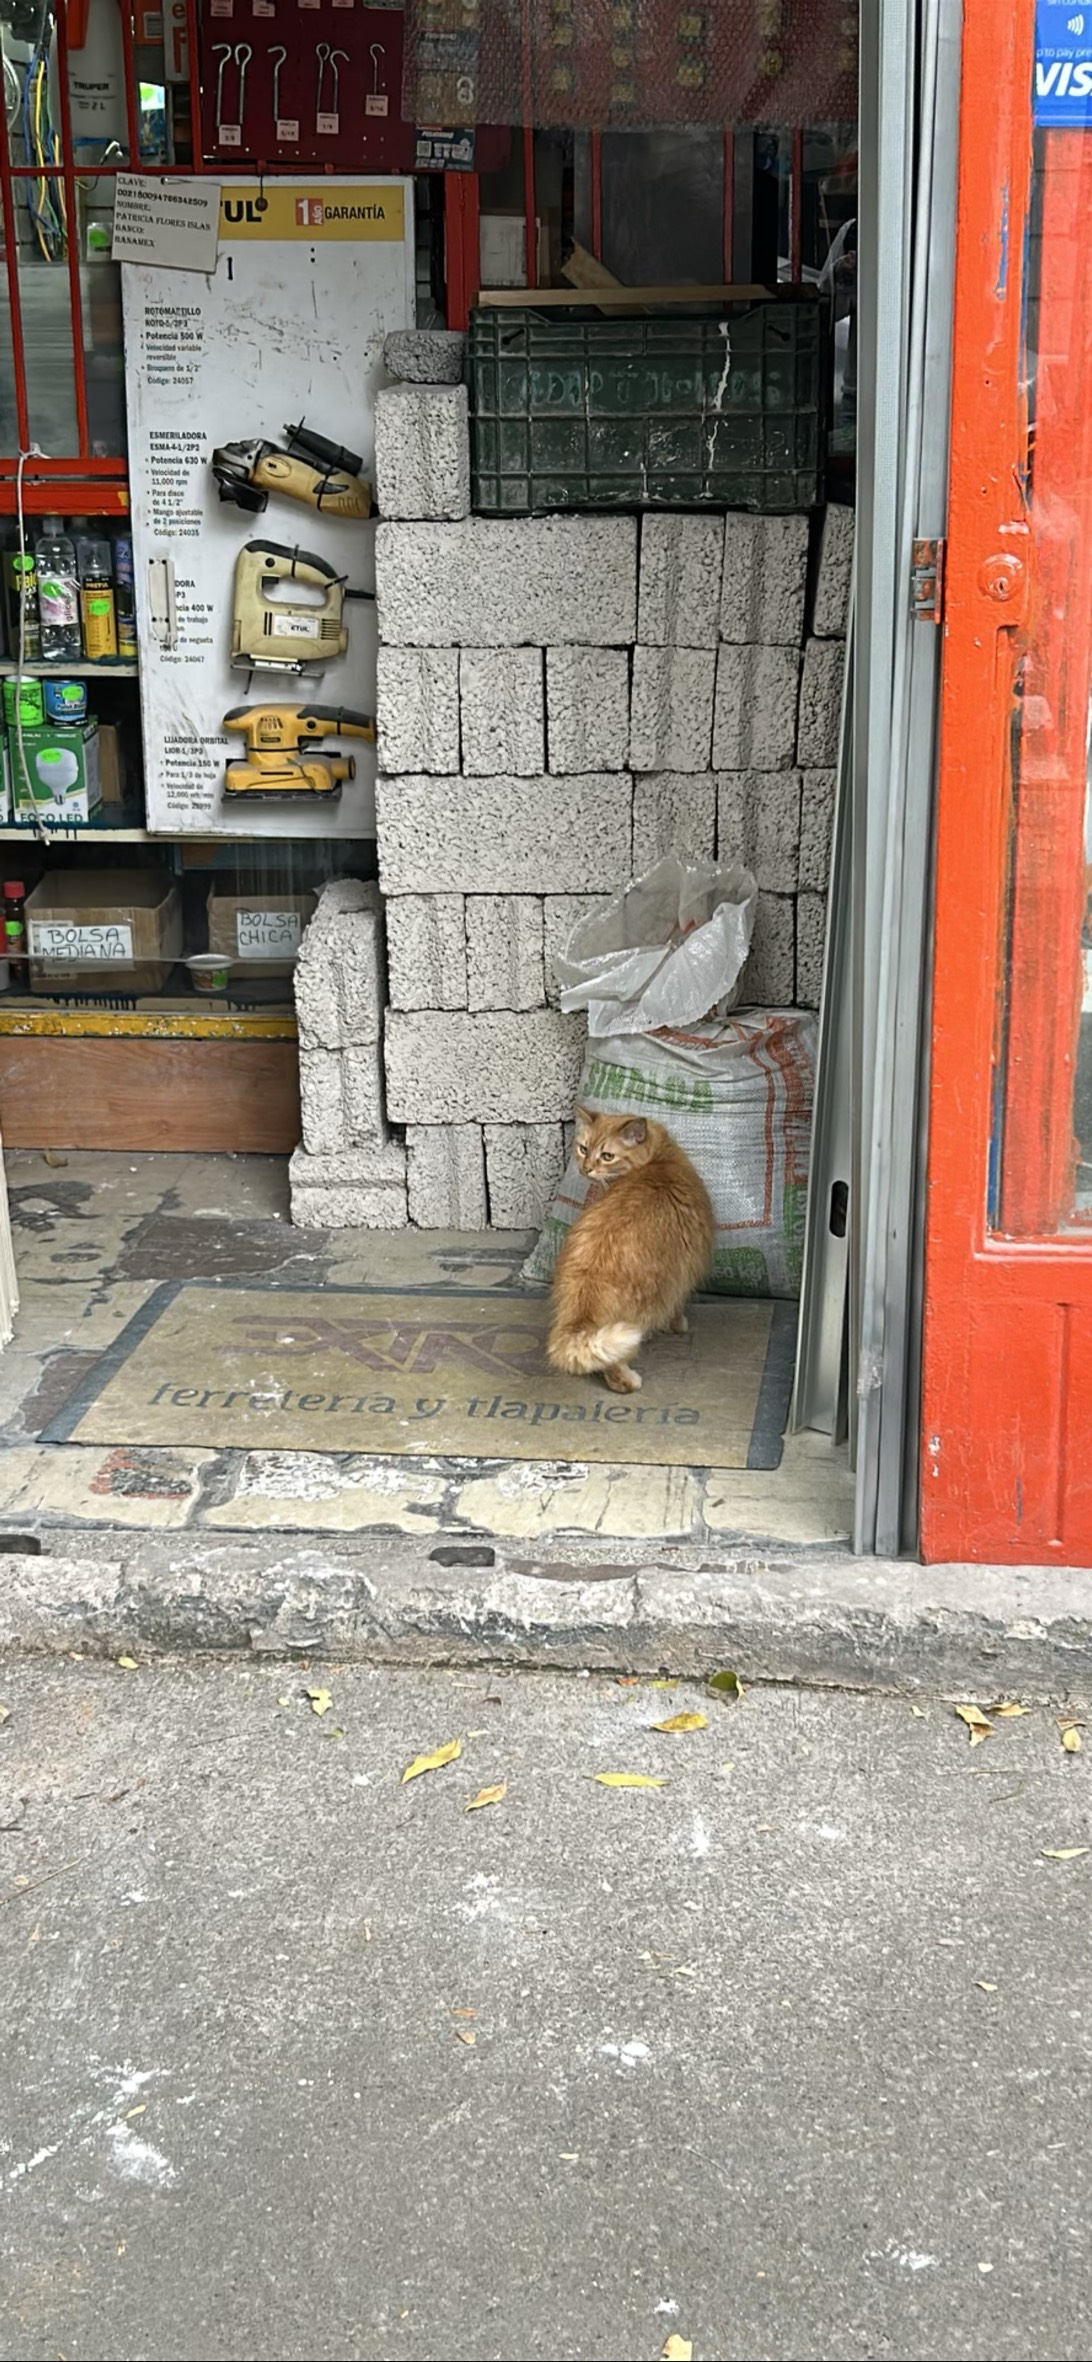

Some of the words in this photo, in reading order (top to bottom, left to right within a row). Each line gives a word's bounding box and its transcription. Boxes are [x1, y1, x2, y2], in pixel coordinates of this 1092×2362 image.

[1036, 62, 1092, 96] VIS
[220, 199, 262, 223] UL
[324, 204, 386, 220] GARANTÍA
[116, 211, 154, 225] PATRICIA
[156, 216, 186, 229] FLORES
[187, 220, 211, 231] ISLAS
[114, 235, 155, 248] BANAMEX
[149, 431, 208, 440] ESMERILADORA
[150, 456, 183, 465] Potencia
[152, 489, 166, 497] Para
[174, 580, 196, 588] DORA
[163, 736, 198, 744] LIJADORA
[199, 737, 229, 745] ORBITAL
[165, 760, 197, 768] Potencia
[236, 908, 299, 929] BOLSA
[48, 927, 119, 944] BOLSA
[239, 929, 293, 946] CHICA
[42, 942, 127, 961] MEDIANA
[147, 1382, 397, 1414] ferretería
[407, 1397, 446, 1420] y
[466, 1395, 700, 1427] tlapalería
